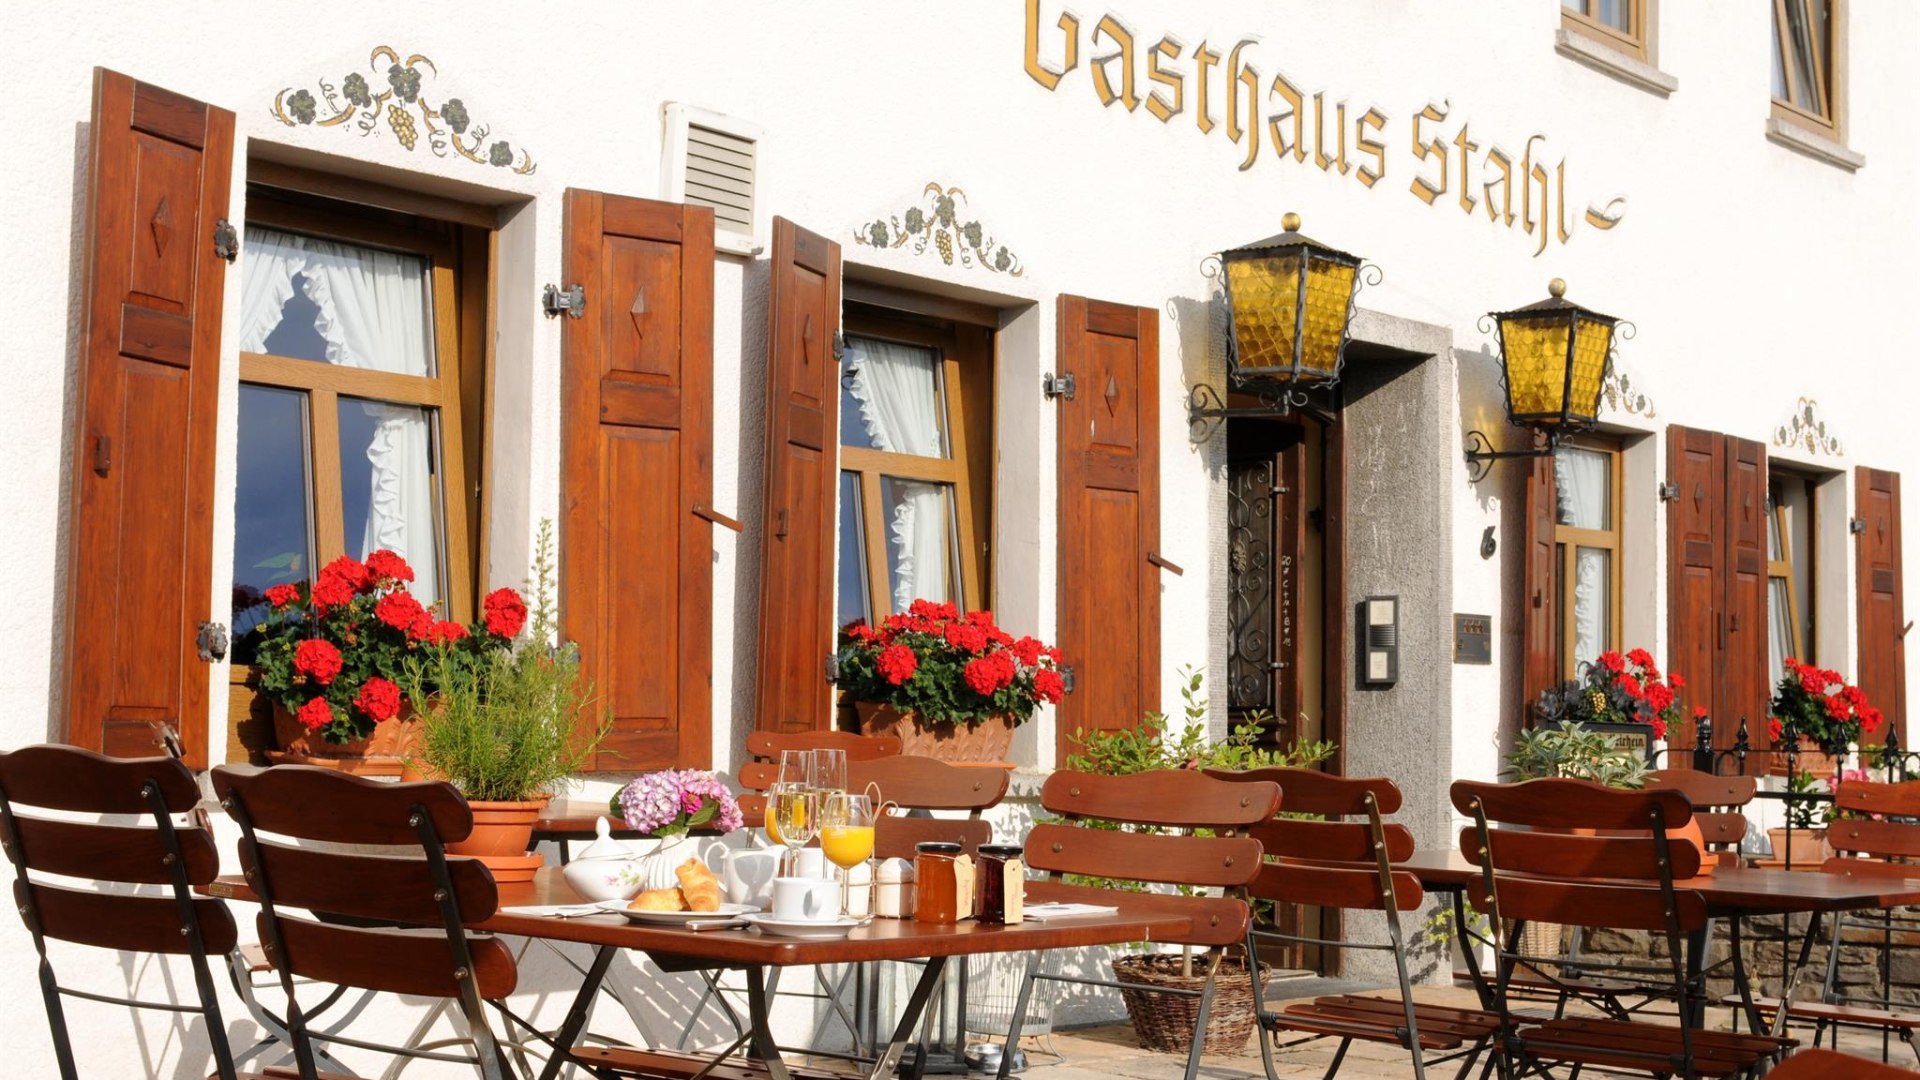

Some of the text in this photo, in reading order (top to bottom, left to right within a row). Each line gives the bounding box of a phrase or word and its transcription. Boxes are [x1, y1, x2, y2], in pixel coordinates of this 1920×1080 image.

[1024, 0, 1572, 258] Gasthaus Stahl
[1480, 525, 1497, 561] 6
